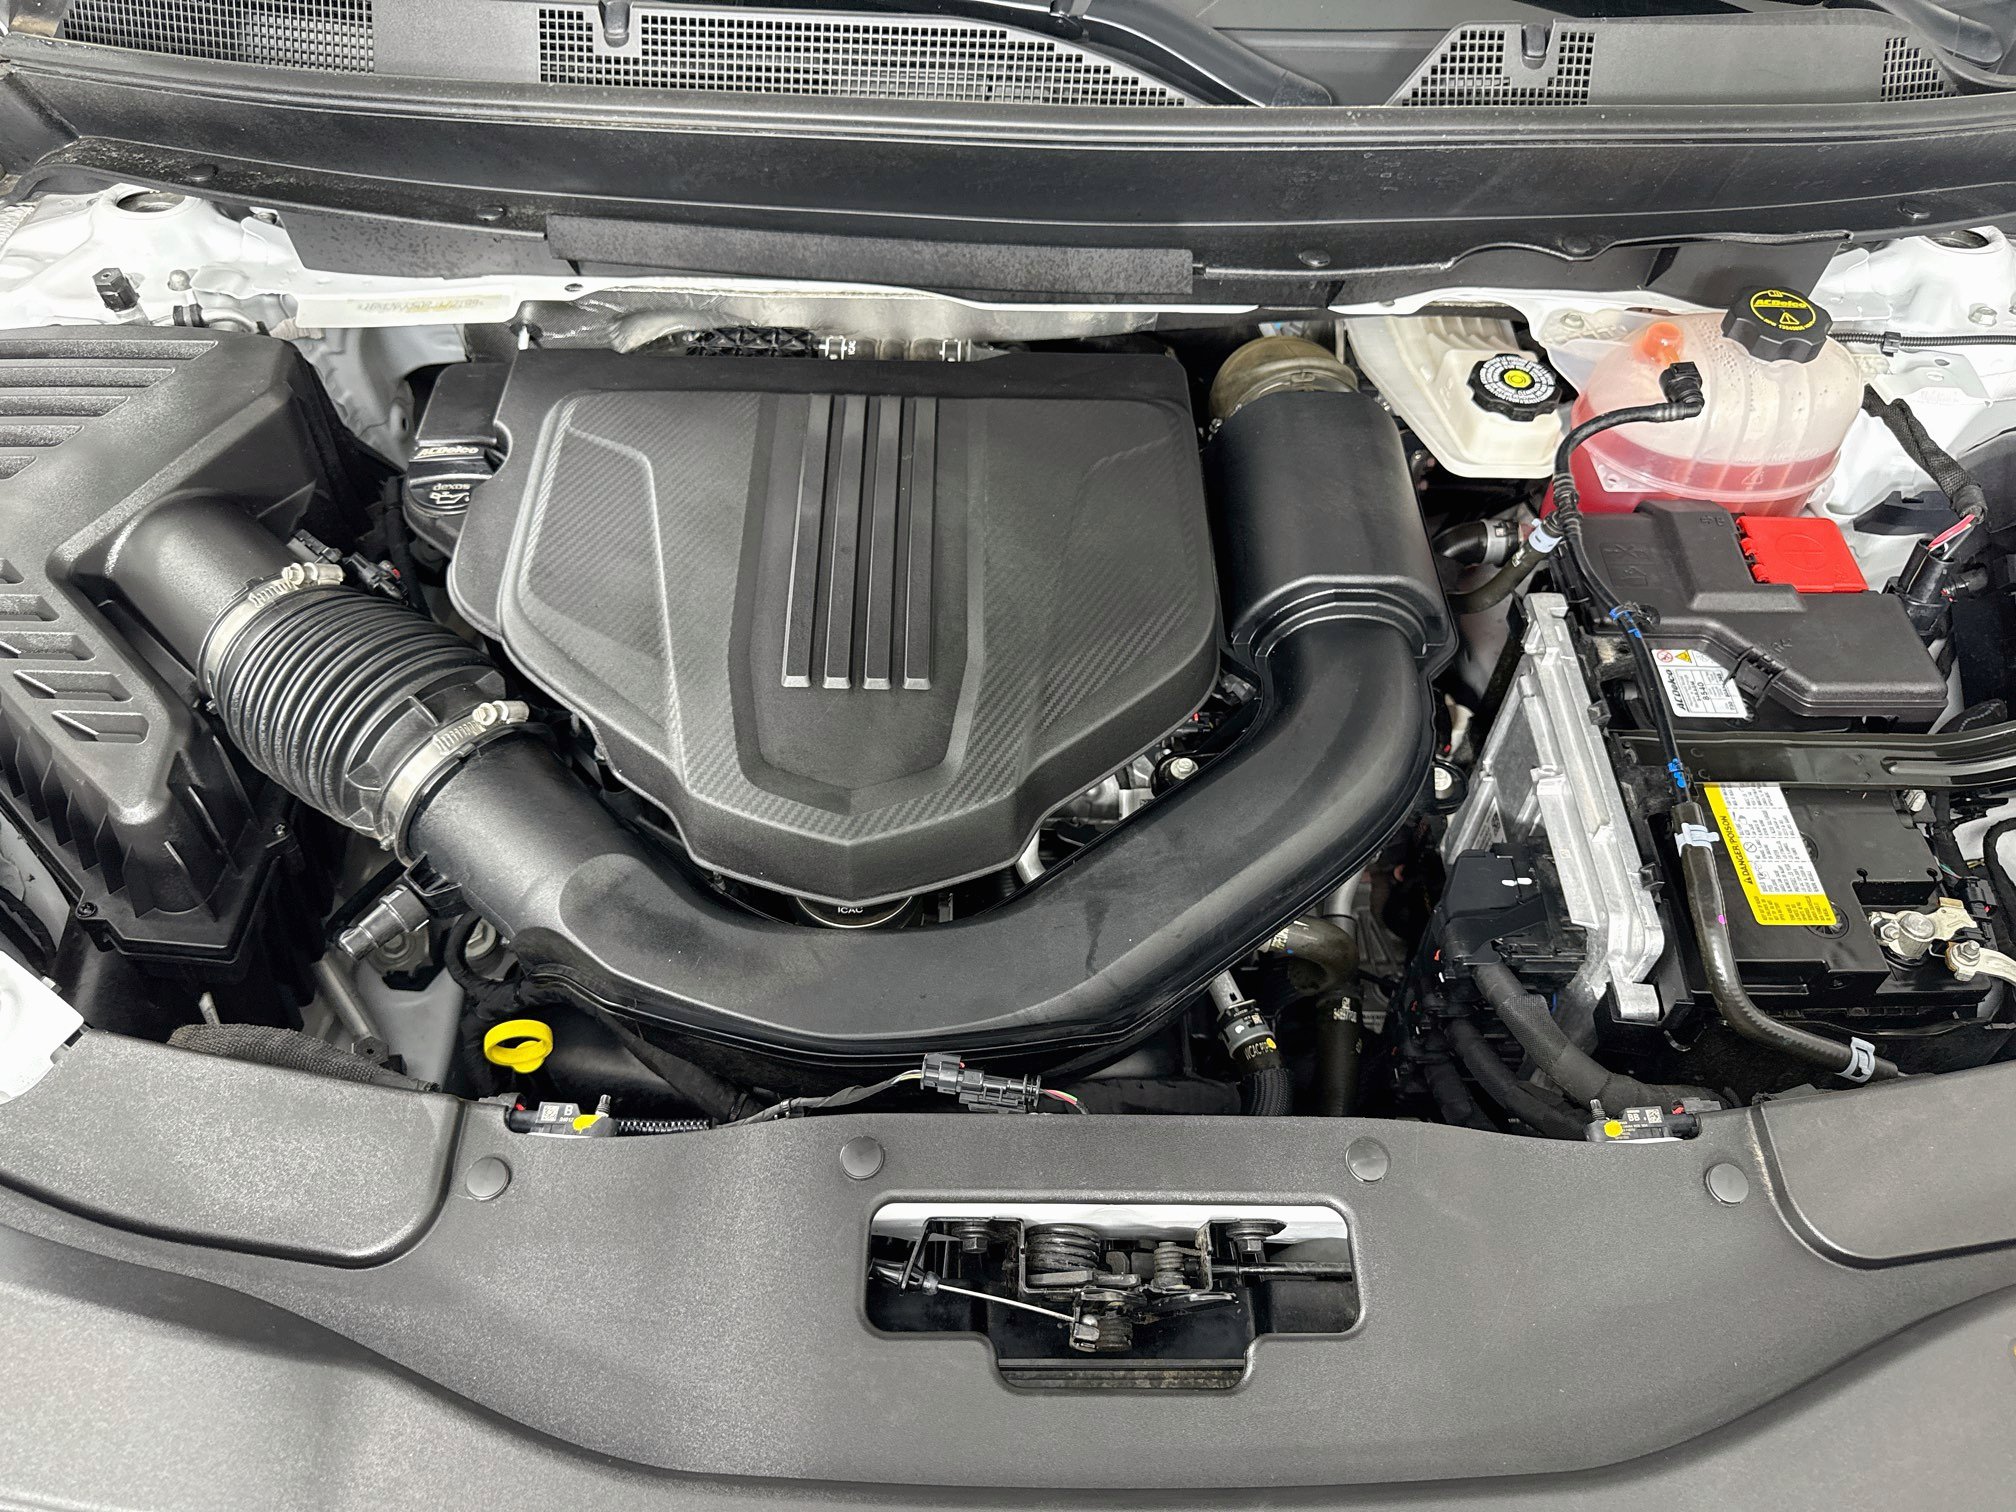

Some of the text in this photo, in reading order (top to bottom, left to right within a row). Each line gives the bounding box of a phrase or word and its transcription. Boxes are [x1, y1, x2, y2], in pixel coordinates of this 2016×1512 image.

[1754, 299, 1809, 309] ACDelco
[432, 482, 471, 491] dexos
[1665, 669, 1686, 711] ACDelco
[564, 1105, 573, 1116] B
[1627, 1113, 1641, 1121] BB
